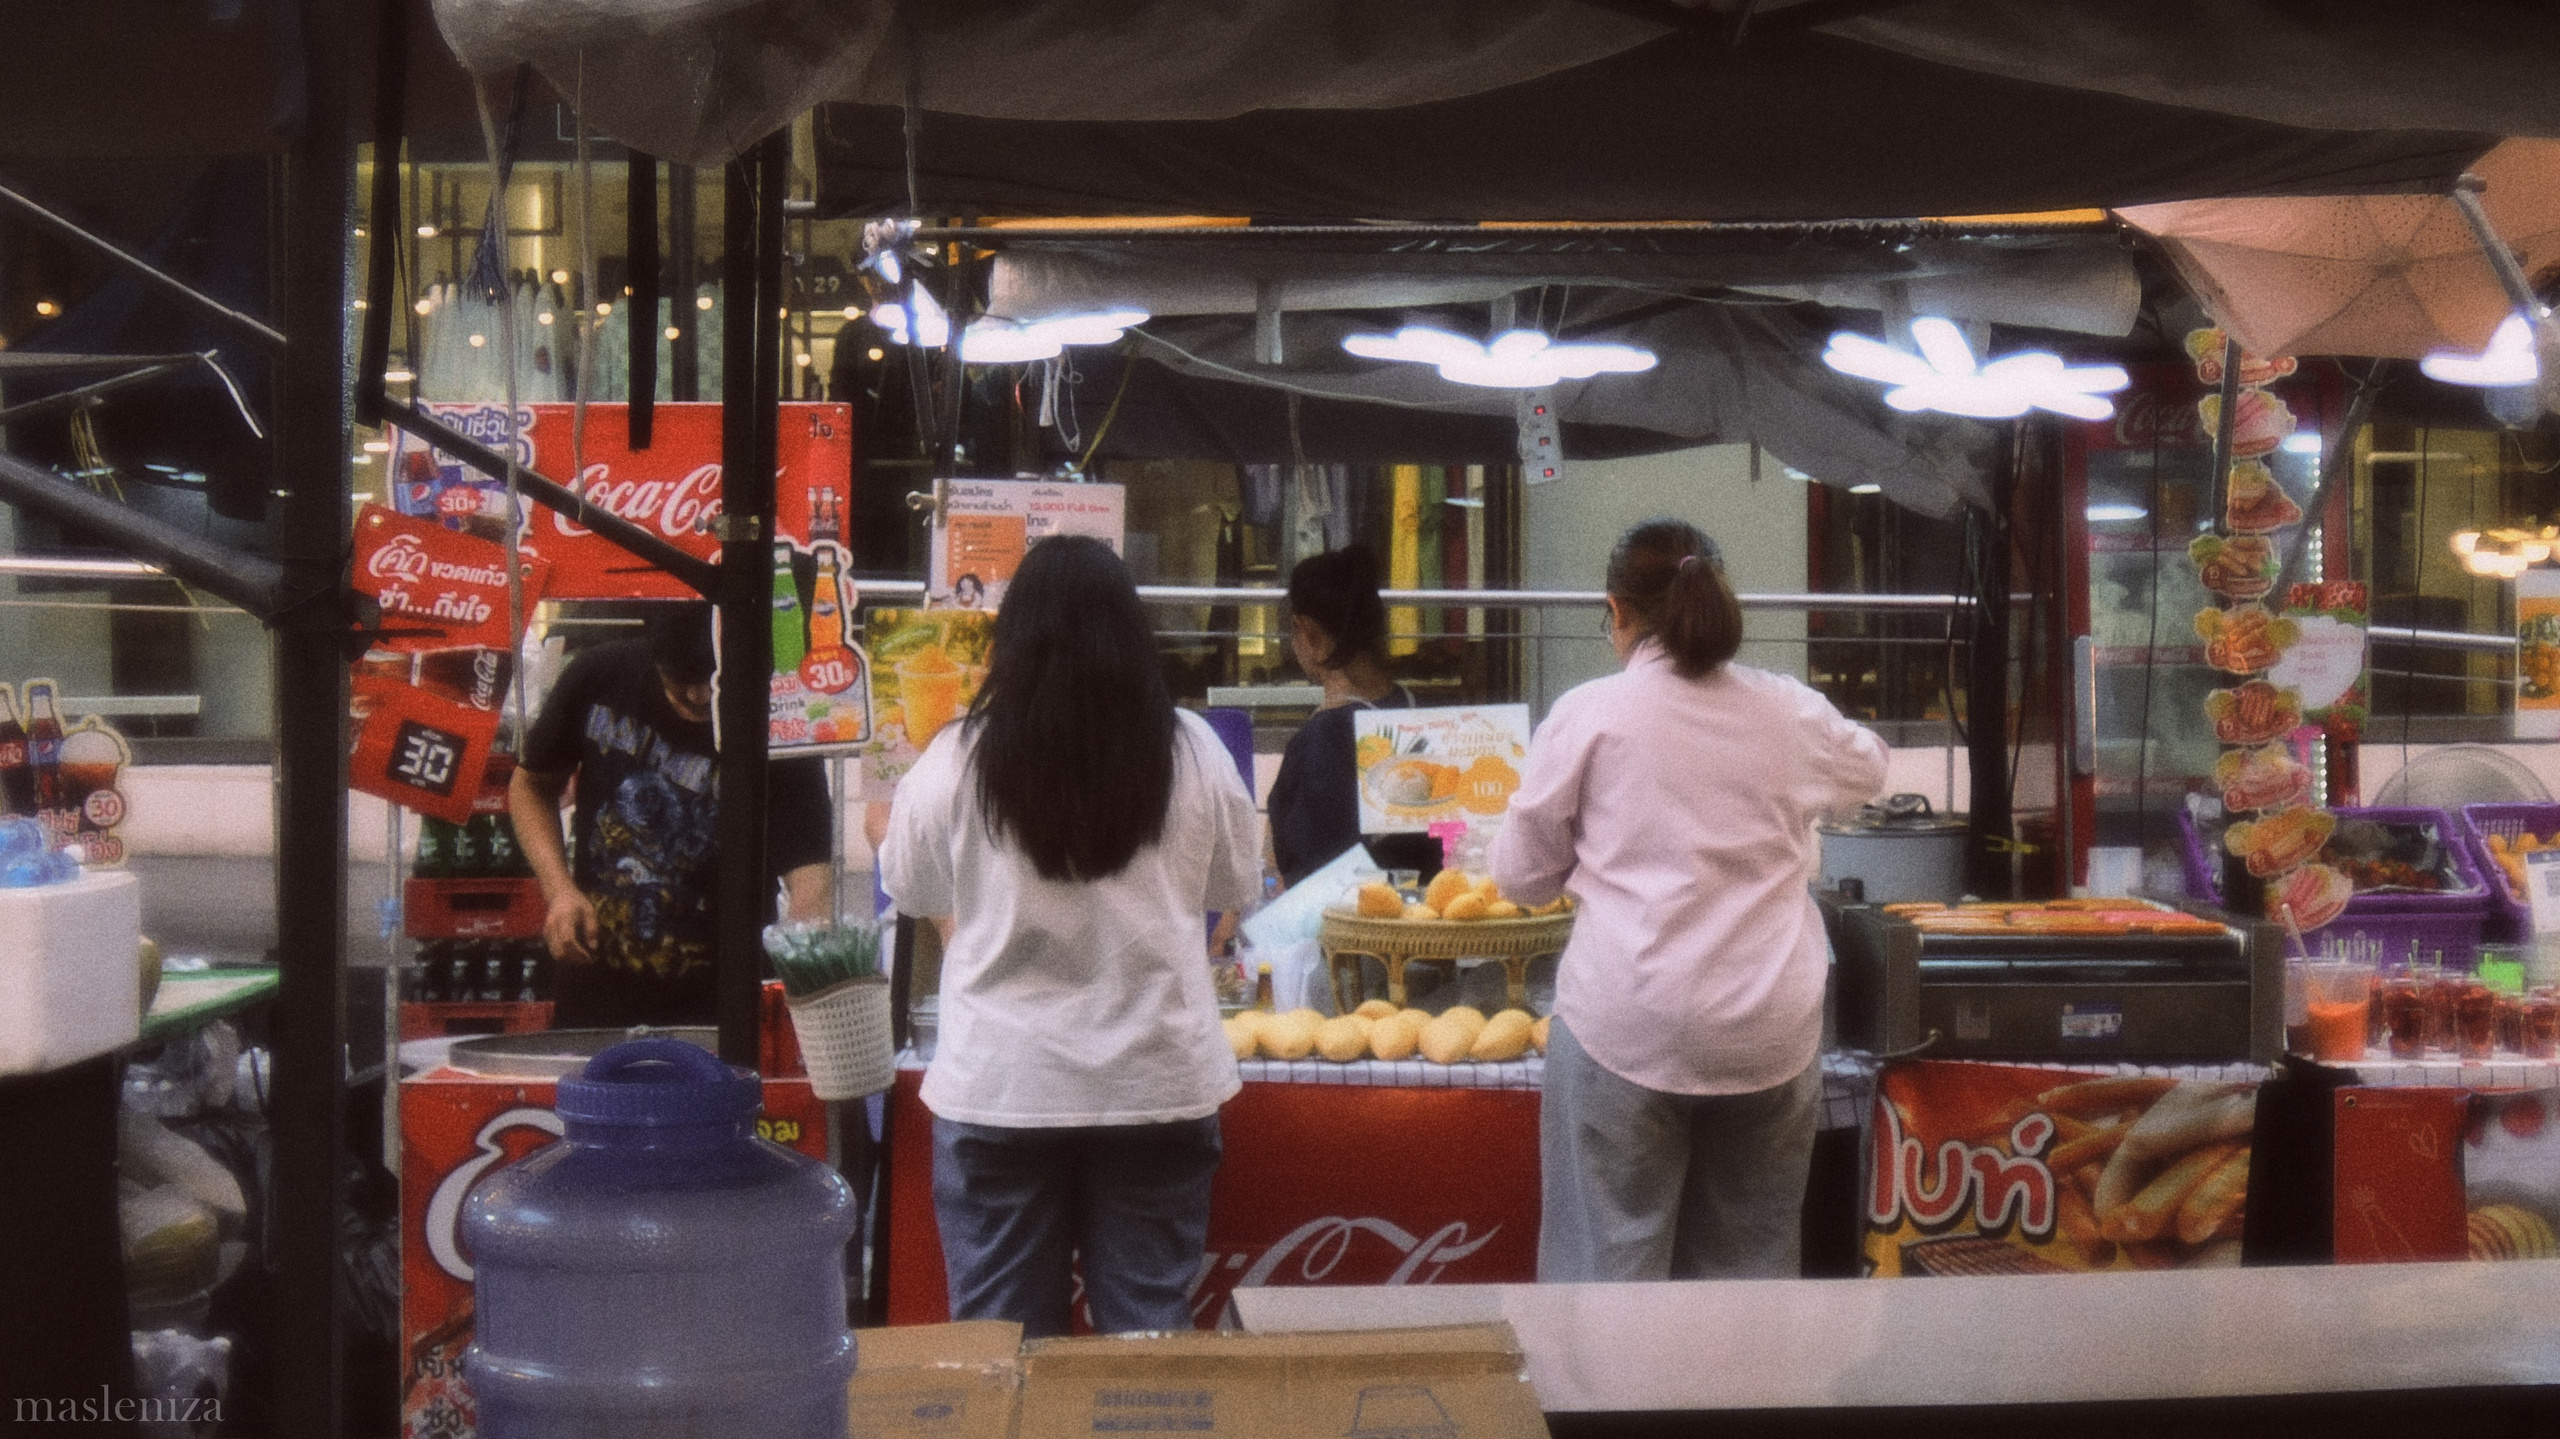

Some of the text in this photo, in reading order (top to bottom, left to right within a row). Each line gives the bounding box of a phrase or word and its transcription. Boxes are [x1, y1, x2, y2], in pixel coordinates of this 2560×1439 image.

[553, 463, 786, 537] Coca-Co
[397, 735, 454, 784] 30
[91, 801, 118, 818] 30
